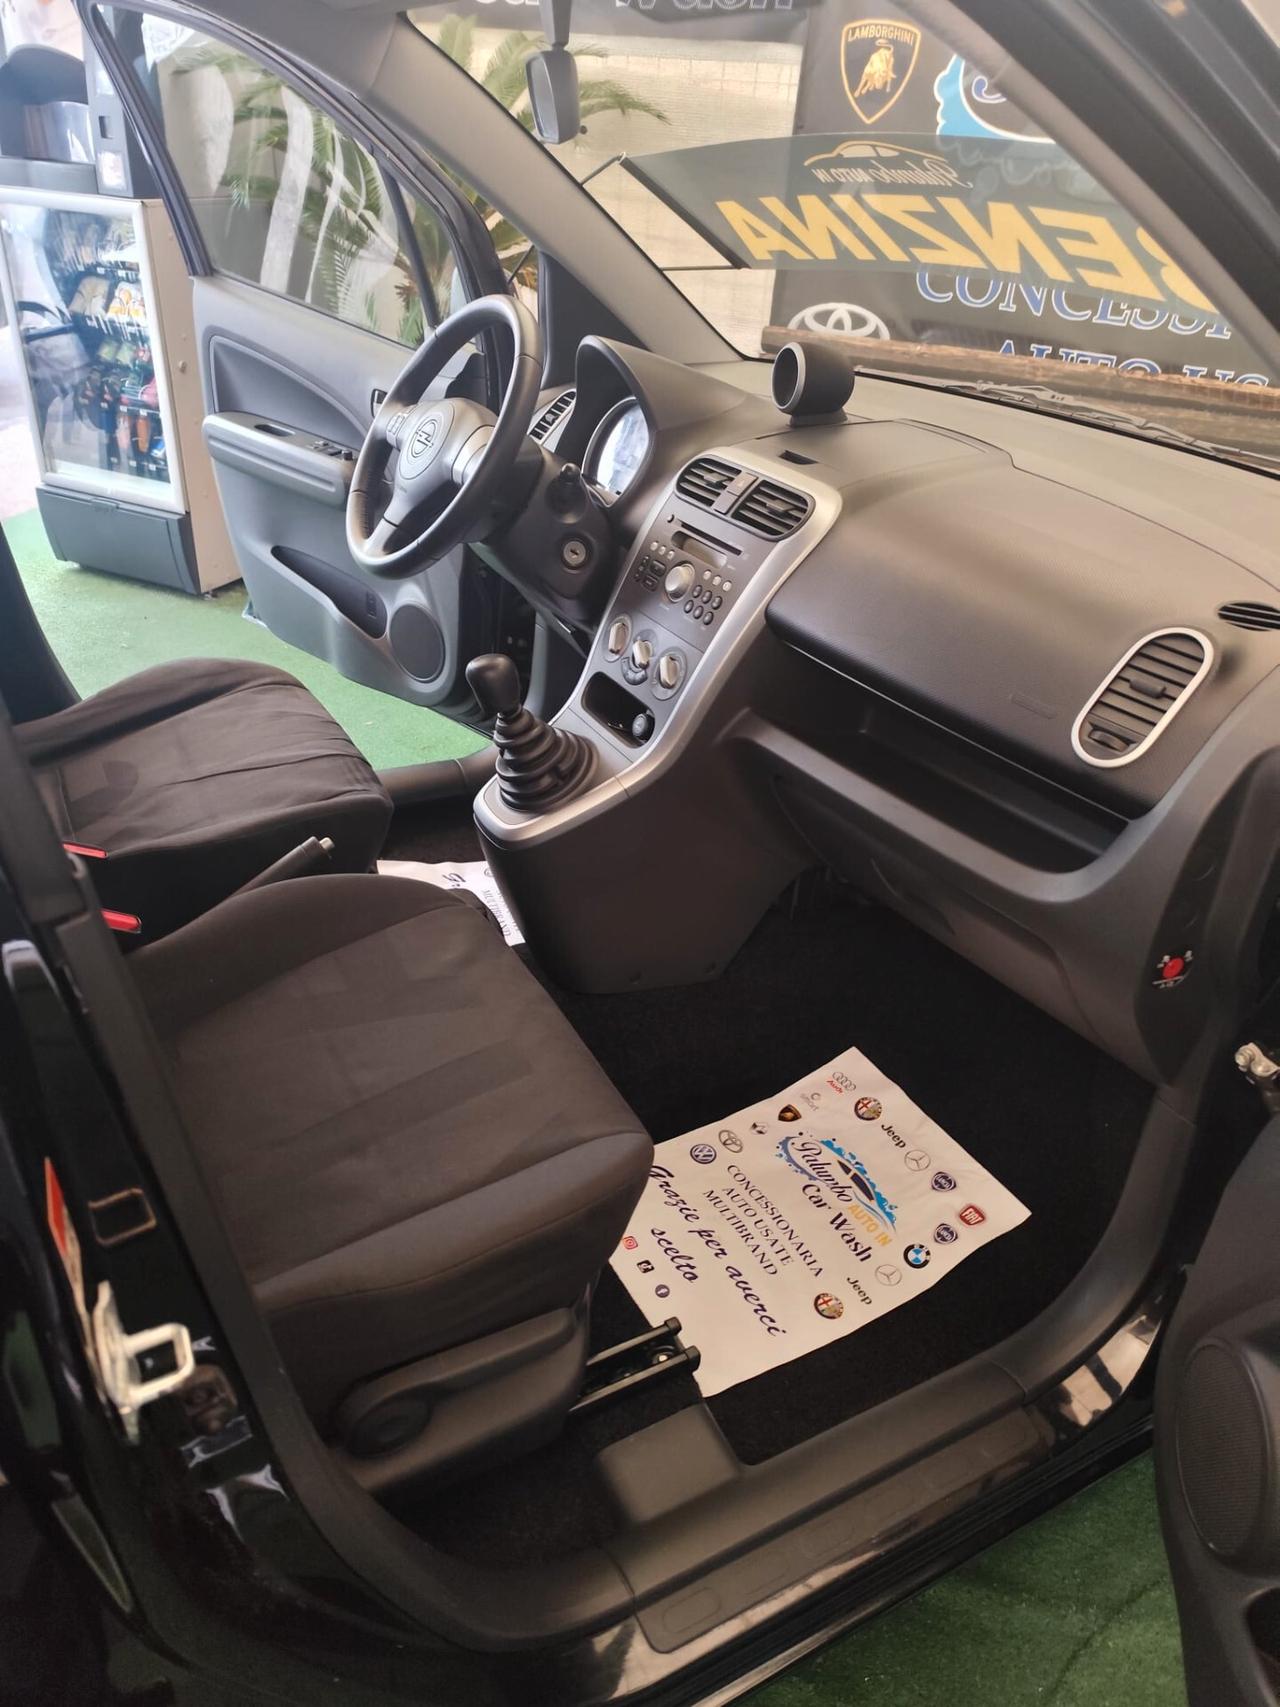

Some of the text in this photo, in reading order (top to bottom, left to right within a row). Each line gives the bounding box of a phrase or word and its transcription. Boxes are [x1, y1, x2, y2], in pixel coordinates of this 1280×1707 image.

[847, 25, 915, 46] LAMBORGHINI
[880, 1123, 907, 1149] Jeep
[703, 1189, 779, 1276] MULTIBRAND
[722, 1187, 793, 1267] AUTO USATE
[727, 1164, 824, 1278] CONCESSIONARIA
[792, 1141, 853, 1203] Palumbo
[849, 1204, 879, 1234] AUTO
[875, 1232, 893, 1247] IN
[802, 1183, 831, 1210] Car
[829, 1211, 873, 1263] Wash
[961, 1207, 984, 1225] FIAT
[650, 1164, 787, 1337] Grazie per averci
[650, 1227, 699, 1284] scelto
[846, 1276, 873, 1306] Jeep
